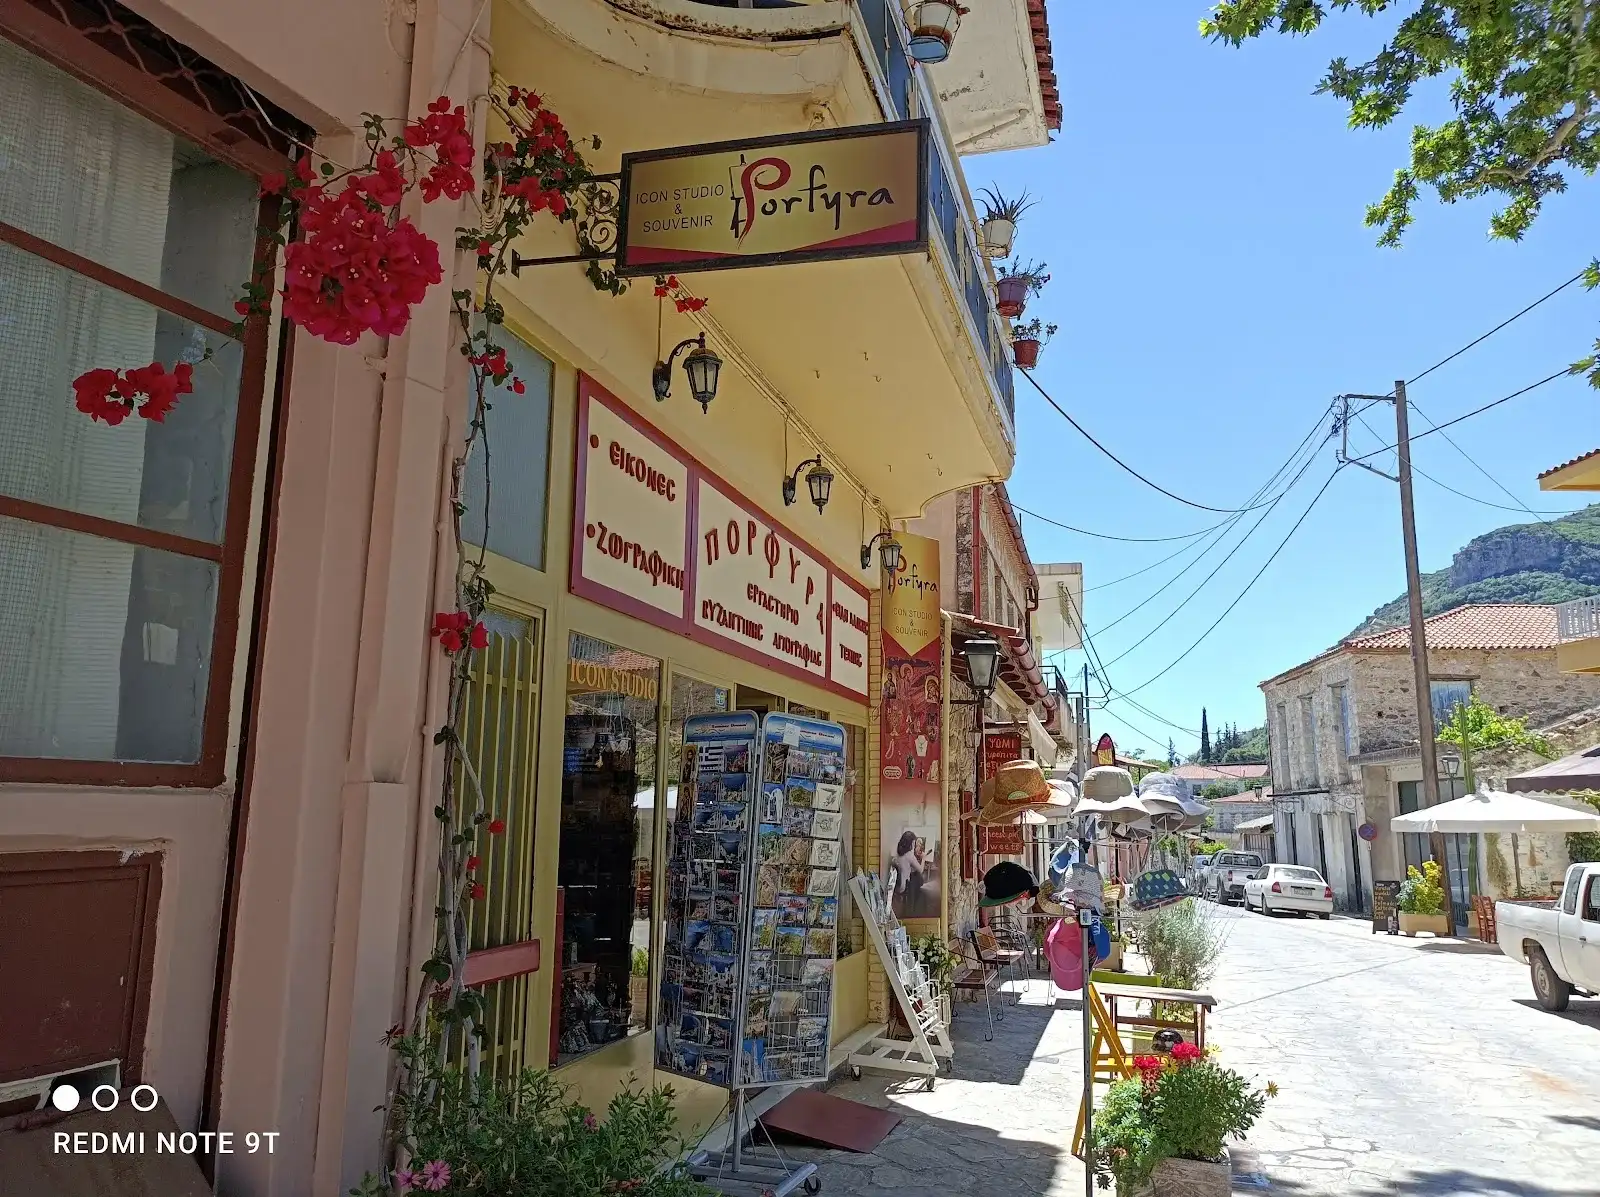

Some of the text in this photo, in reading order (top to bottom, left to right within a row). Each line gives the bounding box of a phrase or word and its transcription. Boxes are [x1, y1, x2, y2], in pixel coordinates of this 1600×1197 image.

[636, 184, 725, 205] ICON STUDIO
[733, 156, 895, 250] Porfyra
[674, 203, 683, 215] &
[643, 215, 714, 233] SOUVENIR
[704, 520, 824, 635] ΠΟΡΦΥΡΑ
[908, 609, 933, 621] STUDIO
[895, 625, 929, 638] SOUVENIR
[569, 657, 657, 701] ICON STUDIO
